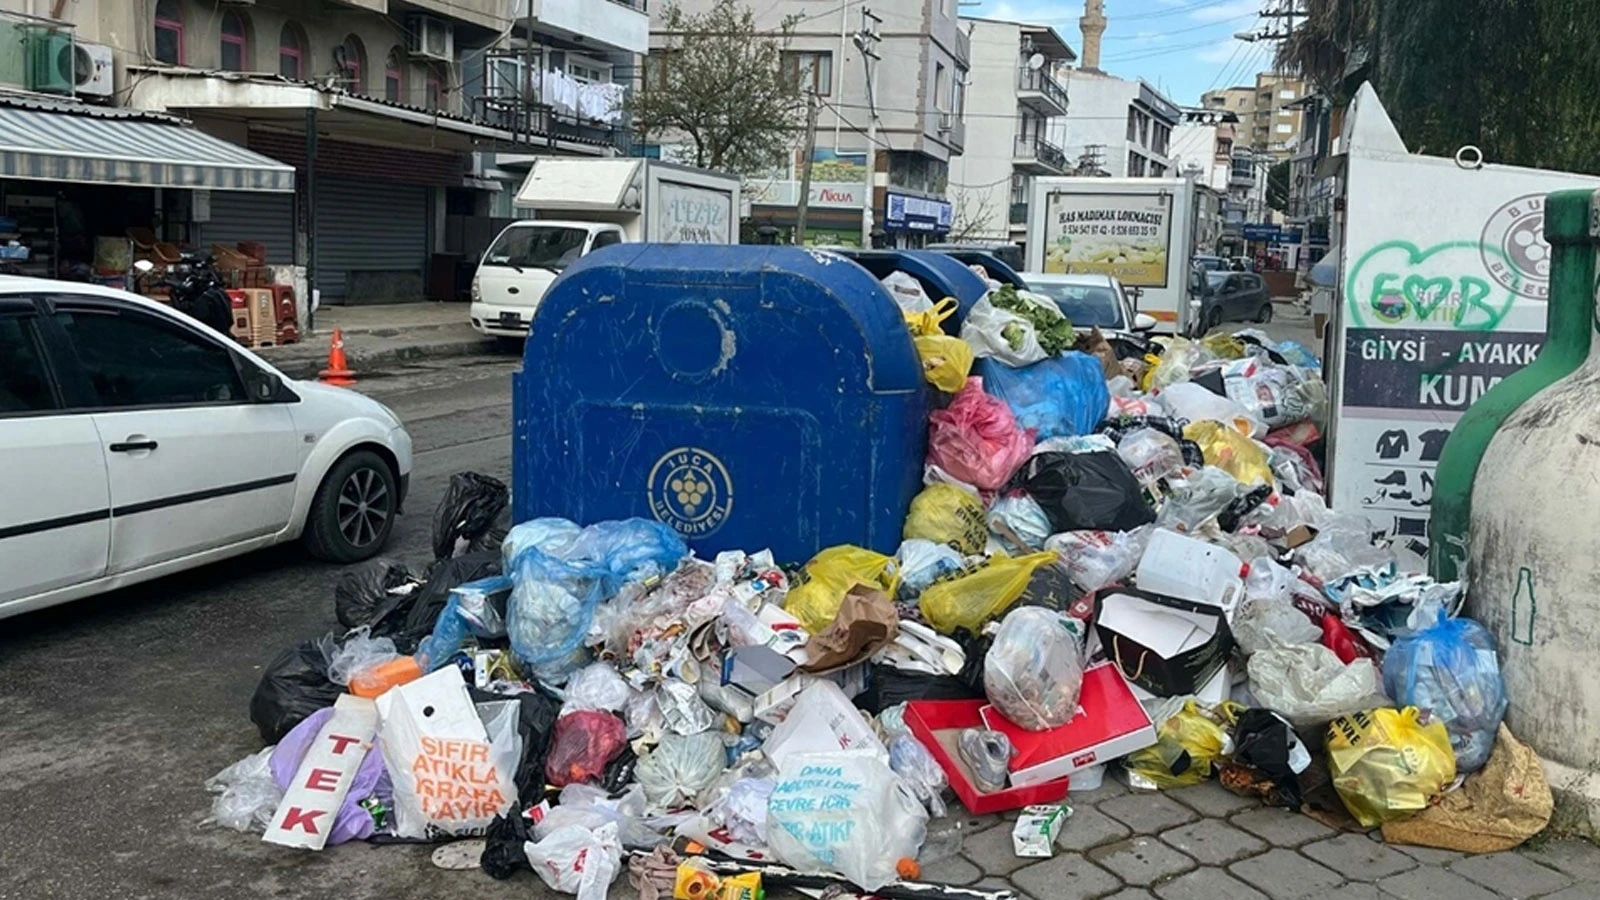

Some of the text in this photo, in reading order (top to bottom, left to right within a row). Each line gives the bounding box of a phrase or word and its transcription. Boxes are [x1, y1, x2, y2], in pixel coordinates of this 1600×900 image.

[1491, 262, 1548, 297] BELED
[1361, 335, 1426, 362] GİYSİ
[1458, 342, 1540, 365] AYAKK
[1419, 374, 1503, 406] KUM
[1332, 715, 1361, 746] EVRE
[421, 736, 489, 762] SIFIR
[280, 734, 361, 835] TEK
[413, 754, 499, 784] ATIKLA
